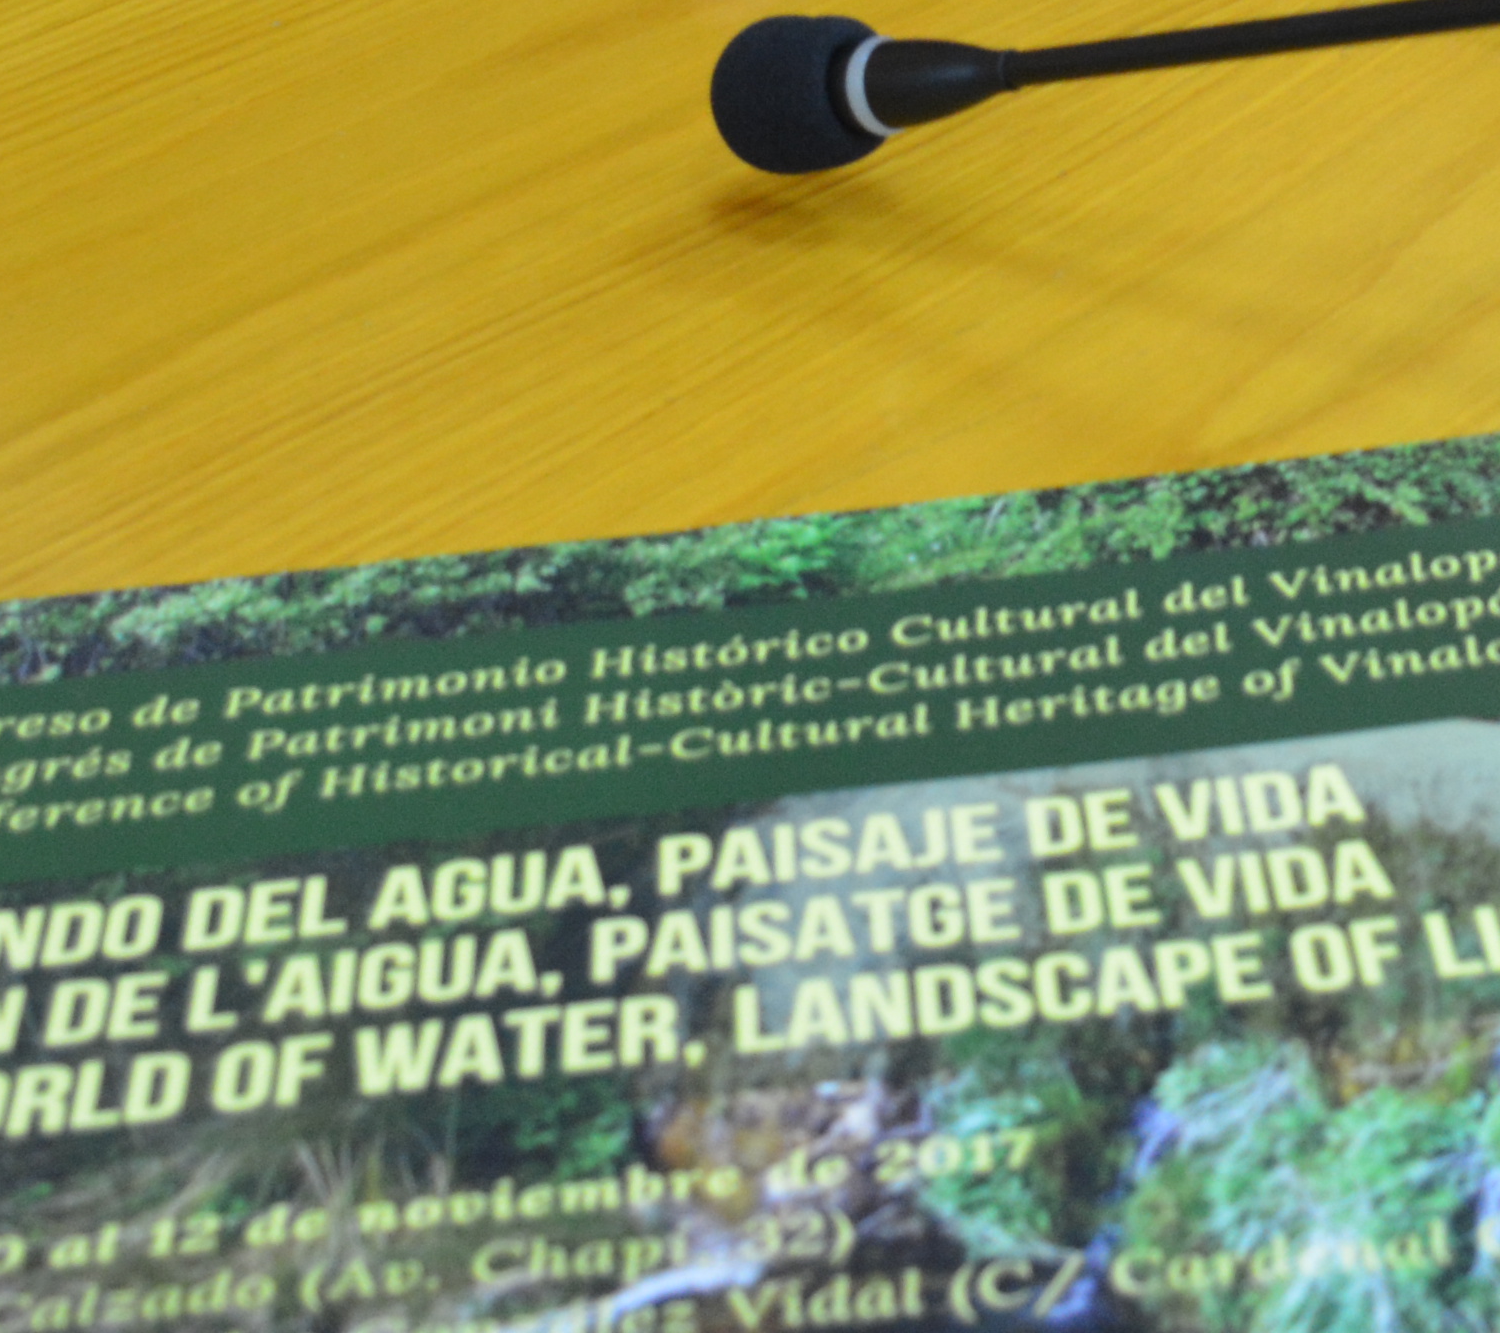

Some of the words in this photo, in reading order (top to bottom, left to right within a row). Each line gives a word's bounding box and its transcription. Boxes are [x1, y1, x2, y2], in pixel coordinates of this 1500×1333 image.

[131, 693, 200, 731] de
[223, 651, 567, 721] Patrimonio
[590, 623, 869, 681] Histórico
[889, 586, 1143, 648] Cultural
[1162, 574, 1249, 617] del
[153, 733, 222, 774] de
[244, 694, 560, 762] Patrimoni
[583, 635, 1125, 724] Històric-Cultural
[1143, 623, 1233, 664] del
[236, 769, 303, 813] of
[319, 699, 931, 800] Historical-Cultural
[952, 670, 1221, 731] Heritage
[1241, 656, 1301, 700] of
[183, 875, 347, 953] DEL
[365, 843, 631, 931] AGUA,
[656, 802, 1004, 898] PAISAJE
[1023, 787, 1141, 861] DE
[1152, 762, 1368, 842] VIDA
[43, 971, 169, 1050] DE
[186, 926, 562, 1034] L'AIGUA,
[589, 876, 1019, 983] PAISATGE
[1040, 863, 1162, 936] DE
[1173, 837, 1398, 921] VIDA
[211, 1034, 335, 1116] OF
[354, 993, 706, 1097] WATER,
[731, 930, 1274, 1058] LANDSCAPE
[1290, 915, 1403, 994] OF
[47, 1223, 120, 1268] al
[147, 1213, 222, 1258] 12
[244, 1201, 331, 1247] de
[356, 1161, 742, 1233] noviembre
[762, 1149, 850, 1195] de
[875, 1127, 1040, 1186] 2017
[726, 1266, 925, 1333] Vidal
[949, 1250, 1085, 1323] (C/
[1108, 1218, 1452, 1299] Cardenal
[302, 1253, 441, 1312] (Av.
